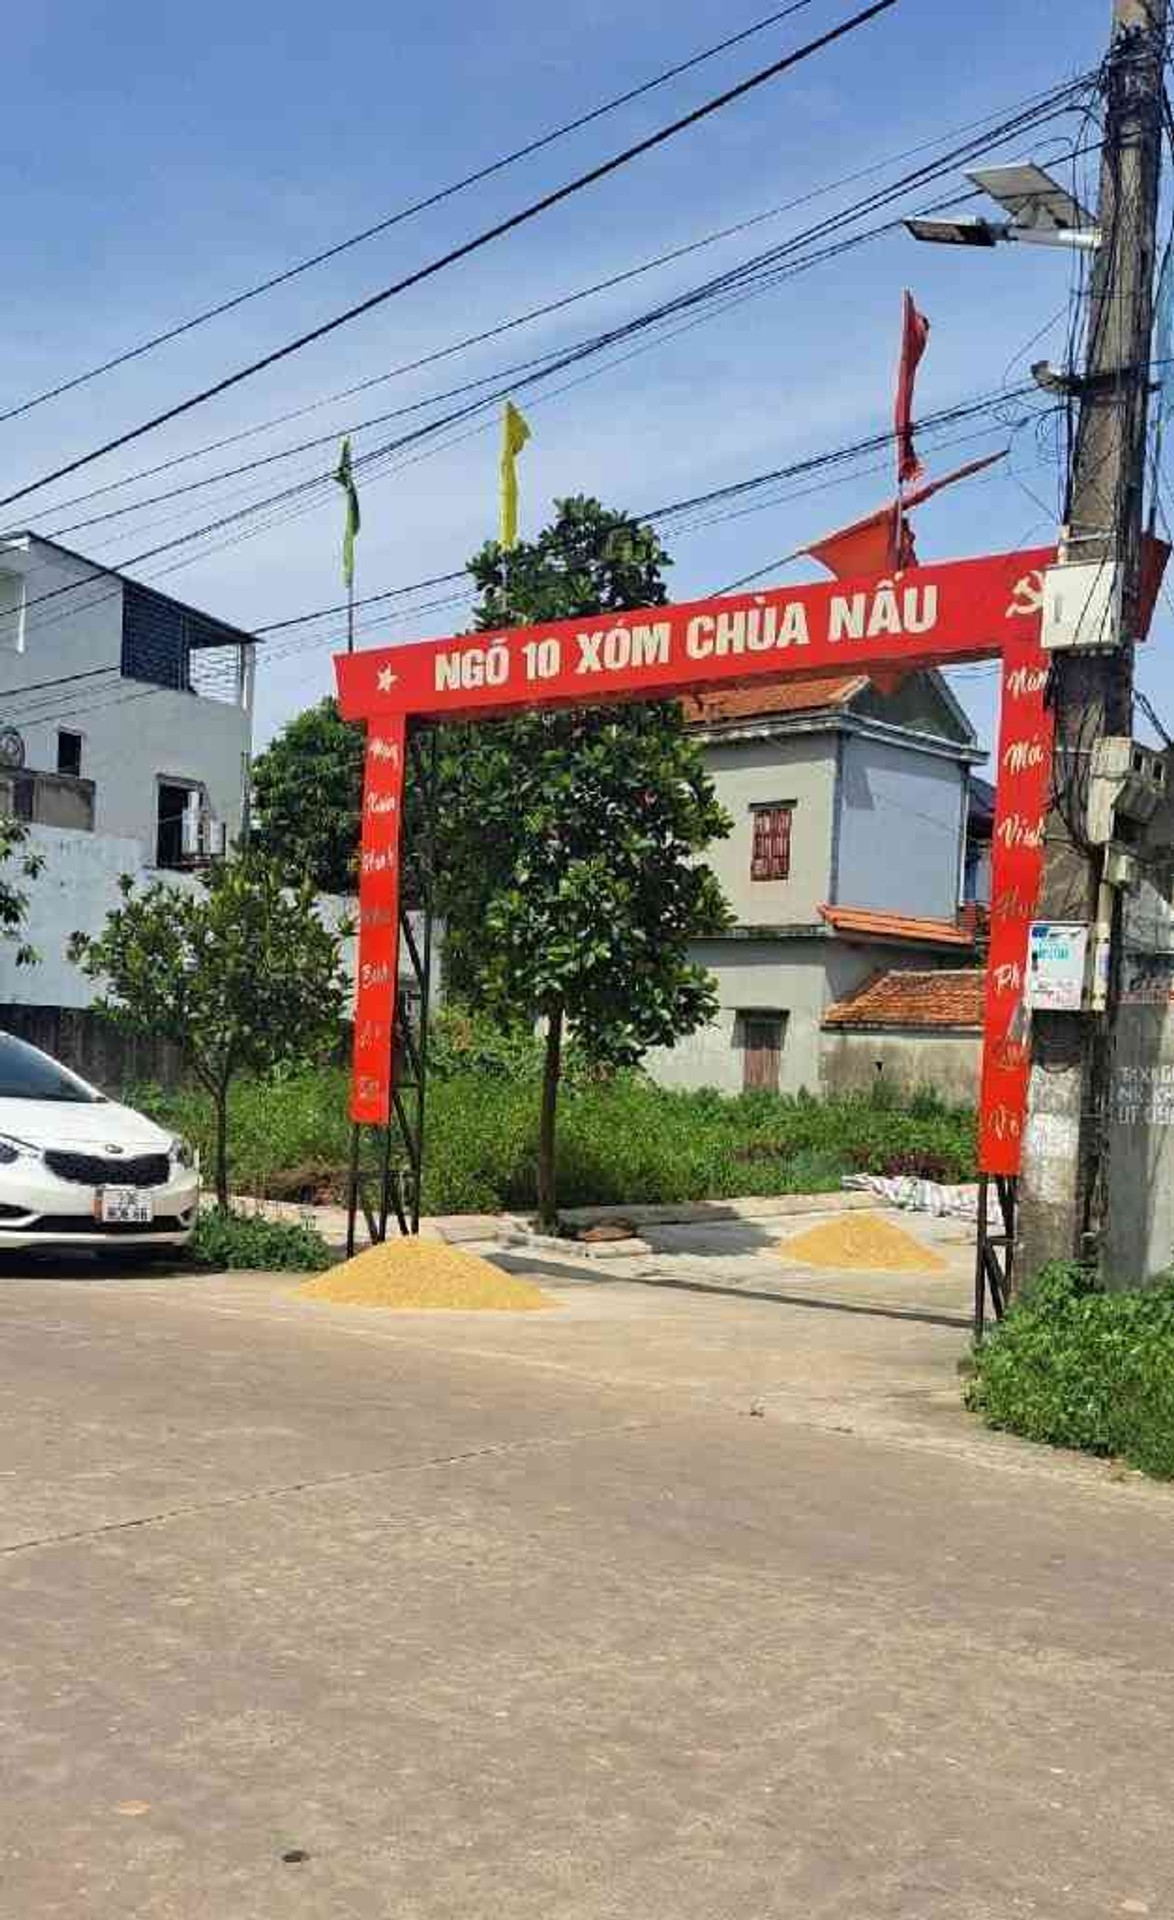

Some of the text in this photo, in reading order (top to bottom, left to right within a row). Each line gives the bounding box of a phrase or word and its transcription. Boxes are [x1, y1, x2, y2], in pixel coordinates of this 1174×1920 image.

[435, 571, 938, 691] NGÕ 10 XÓM CHÙA NẤU
